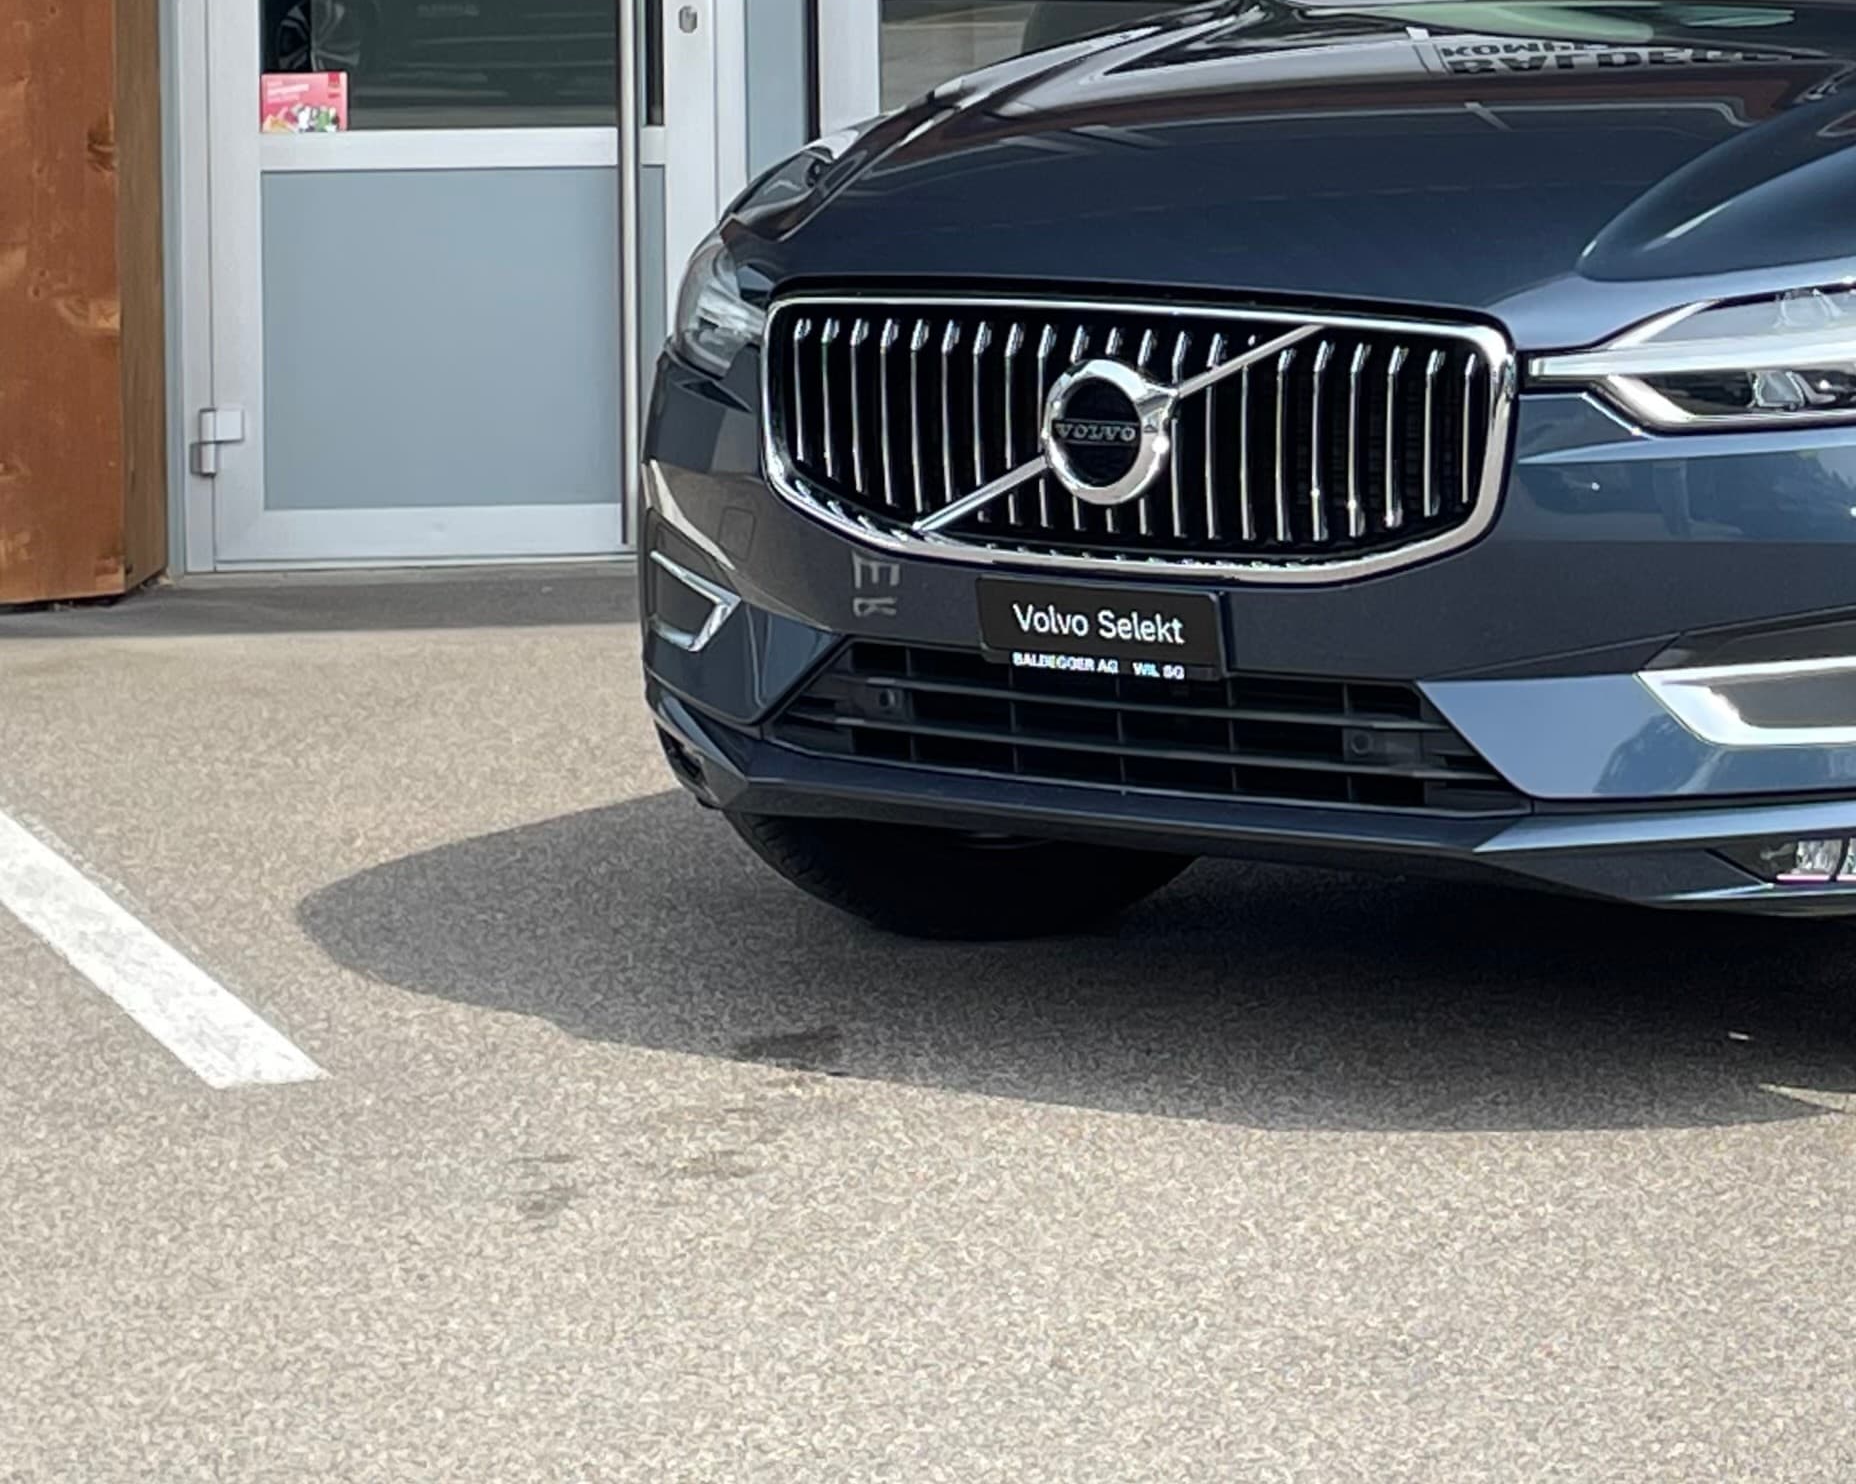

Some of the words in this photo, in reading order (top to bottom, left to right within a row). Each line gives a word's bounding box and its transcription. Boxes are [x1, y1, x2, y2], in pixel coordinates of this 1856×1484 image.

[1054, 422, 1137, 442] VOLVO
[1012, 603, 1090, 638] Volvo
[1097, 609, 1185, 645] Selekt
[1012, 651, 1094, 672] BALDEGGER
[1096, 656, 1120, 674] AG
